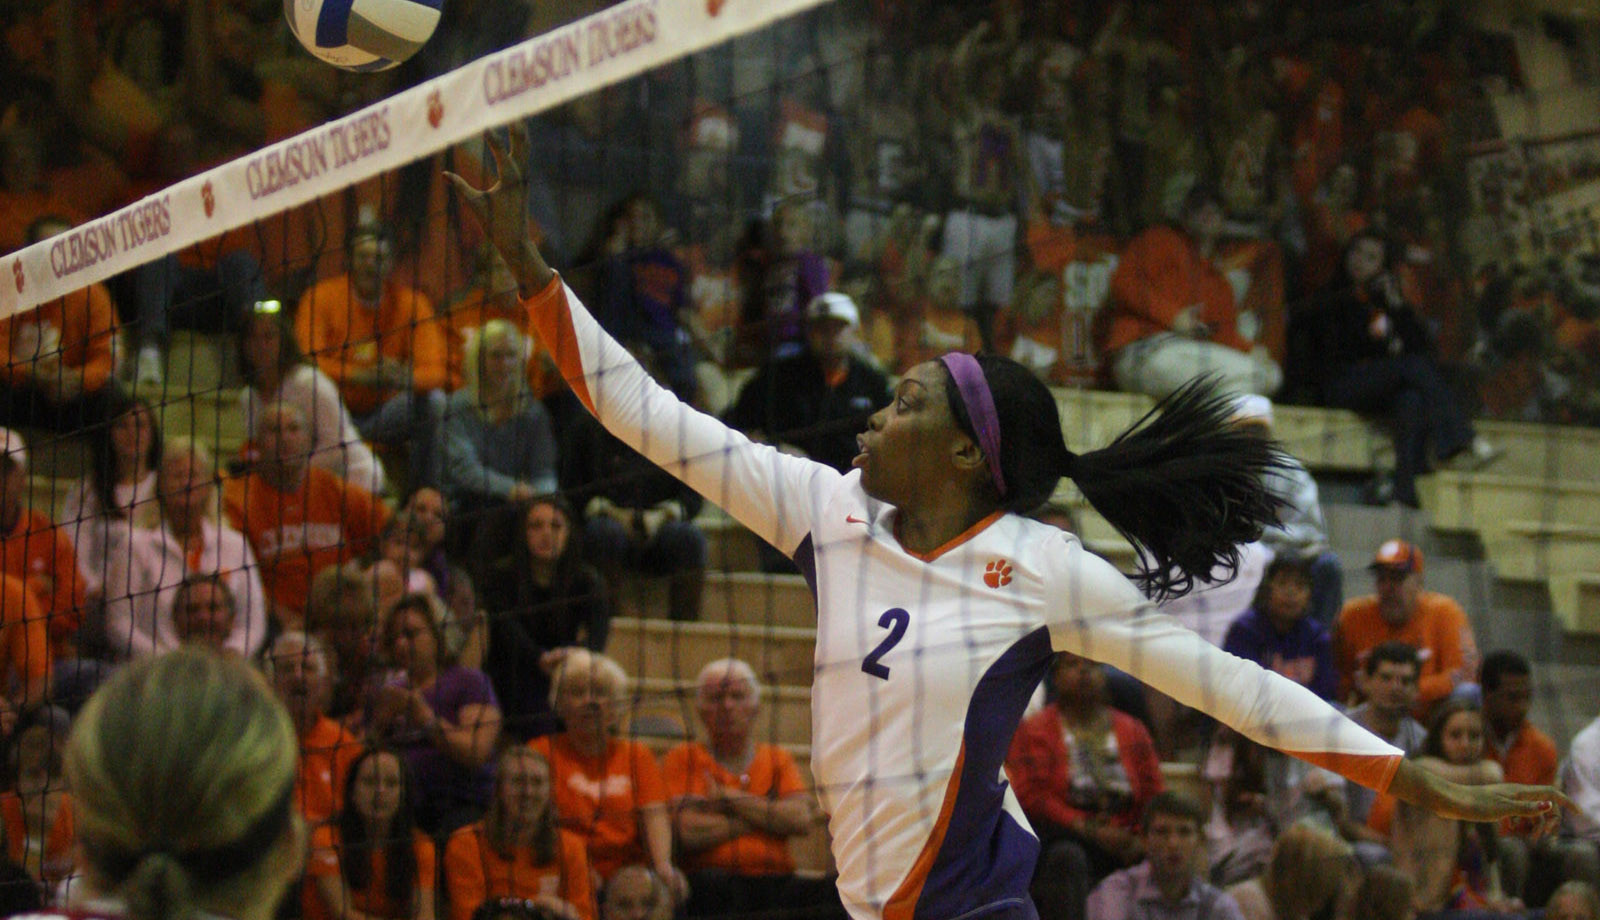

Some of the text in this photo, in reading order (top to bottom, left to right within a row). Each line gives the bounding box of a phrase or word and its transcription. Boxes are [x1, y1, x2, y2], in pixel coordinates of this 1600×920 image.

[483, 25, 581, 106] CLEMSON
[246, 104, 392, 200] CLEMSON TIGERS
[50, 194, 172, 279] CLEMSON TIGERS
[861, 607, 911, 681] 2
